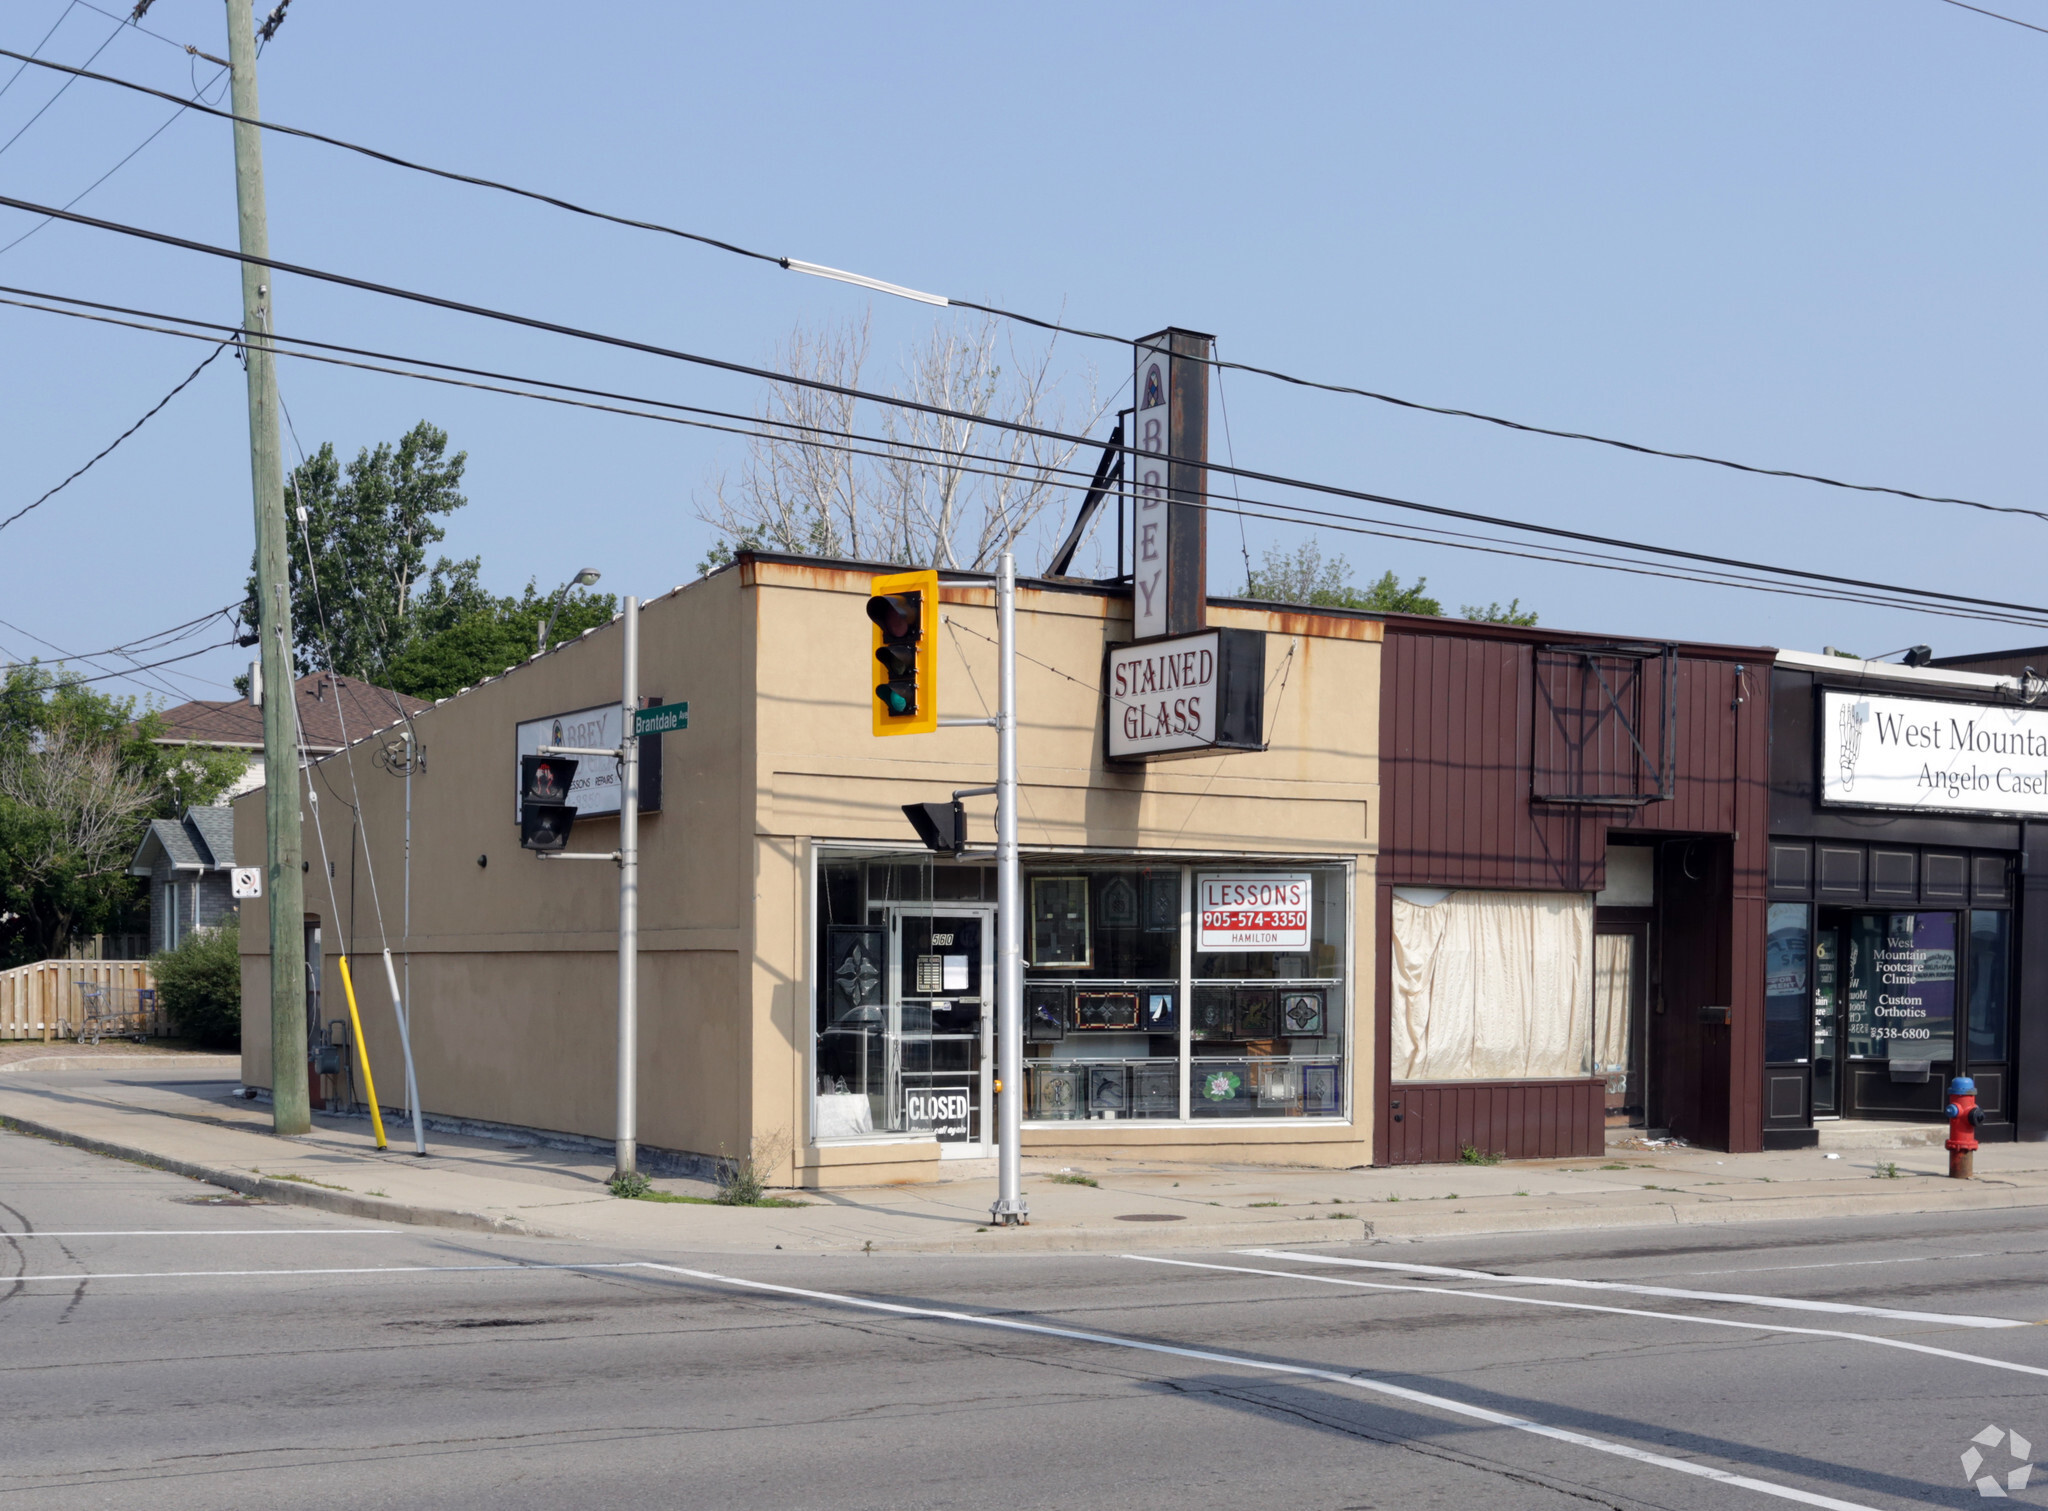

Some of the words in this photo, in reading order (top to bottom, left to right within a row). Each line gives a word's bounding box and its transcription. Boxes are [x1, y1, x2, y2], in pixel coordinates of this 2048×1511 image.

[1140, 363, 1167, 617] ABBEY
[1115, 649, 1213, 698] STAINED
[636, 711, 677, 734] Brantdale
[679, 711, 688, 720] Ave
[1124, 697, 1201, 741] GLASS
[1875, 711, 1941, 749] West
[1949, 718, 2048, 757] Mounta
[569, 777, 591, 791] ESSONS
[595, 774, 613, 786] REPAIRS
[1917, 762, 1990, 799] Angelo
[1996, 767, 2048, 795] Casel
[1208, 884, 1301, 906] LESSONS
[1203, 912, 1306, 927] 905-574-3350
[932, 933, 954, 946] 560
[1232, 933, 1278, 943] HAMILTON
[1887, 937, 1914, 948] West
[1873, 949, 1927, 960] Mountain
[1875, 962, 1925, 973] Footcare
[1882, 973, 1917, 984] Clinic
[1879, 994, 1922, 1006] Custom
[1874, 1006, 1927, 1018] Orthotics
[1877, 1028, 1930, 1039] 538-6800
[909, 1095, 967, 1120] CLOSED
[934, 1125, 947, 1135] call
[947, 1125, 967, 1137] again
